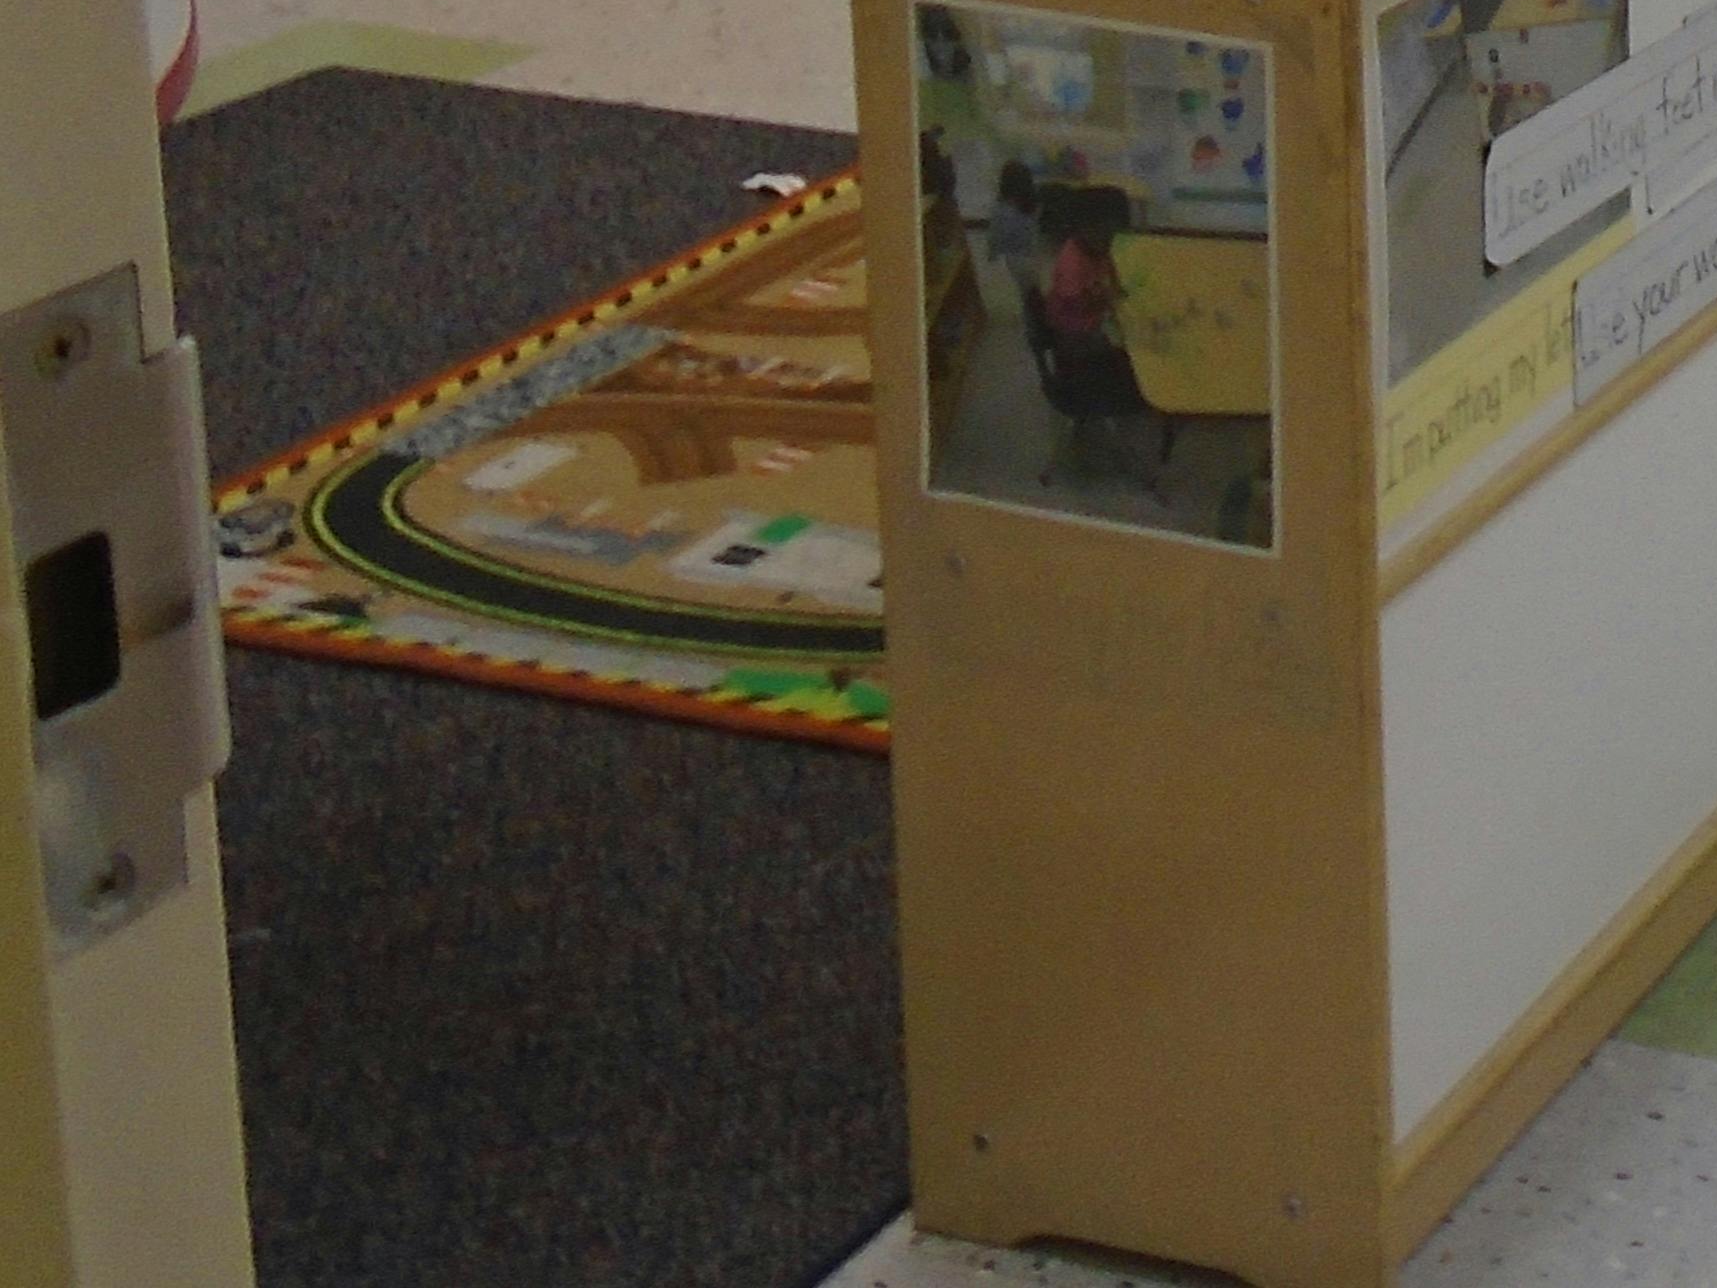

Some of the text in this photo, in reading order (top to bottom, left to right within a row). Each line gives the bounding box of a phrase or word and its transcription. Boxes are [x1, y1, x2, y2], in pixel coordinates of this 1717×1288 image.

[1489, 166, 1551, 241] Use
[1560, 112, 1648, 197] walking
[1656, 55, 1704, 134] feet
[1632, 260, 1689, 356] your
